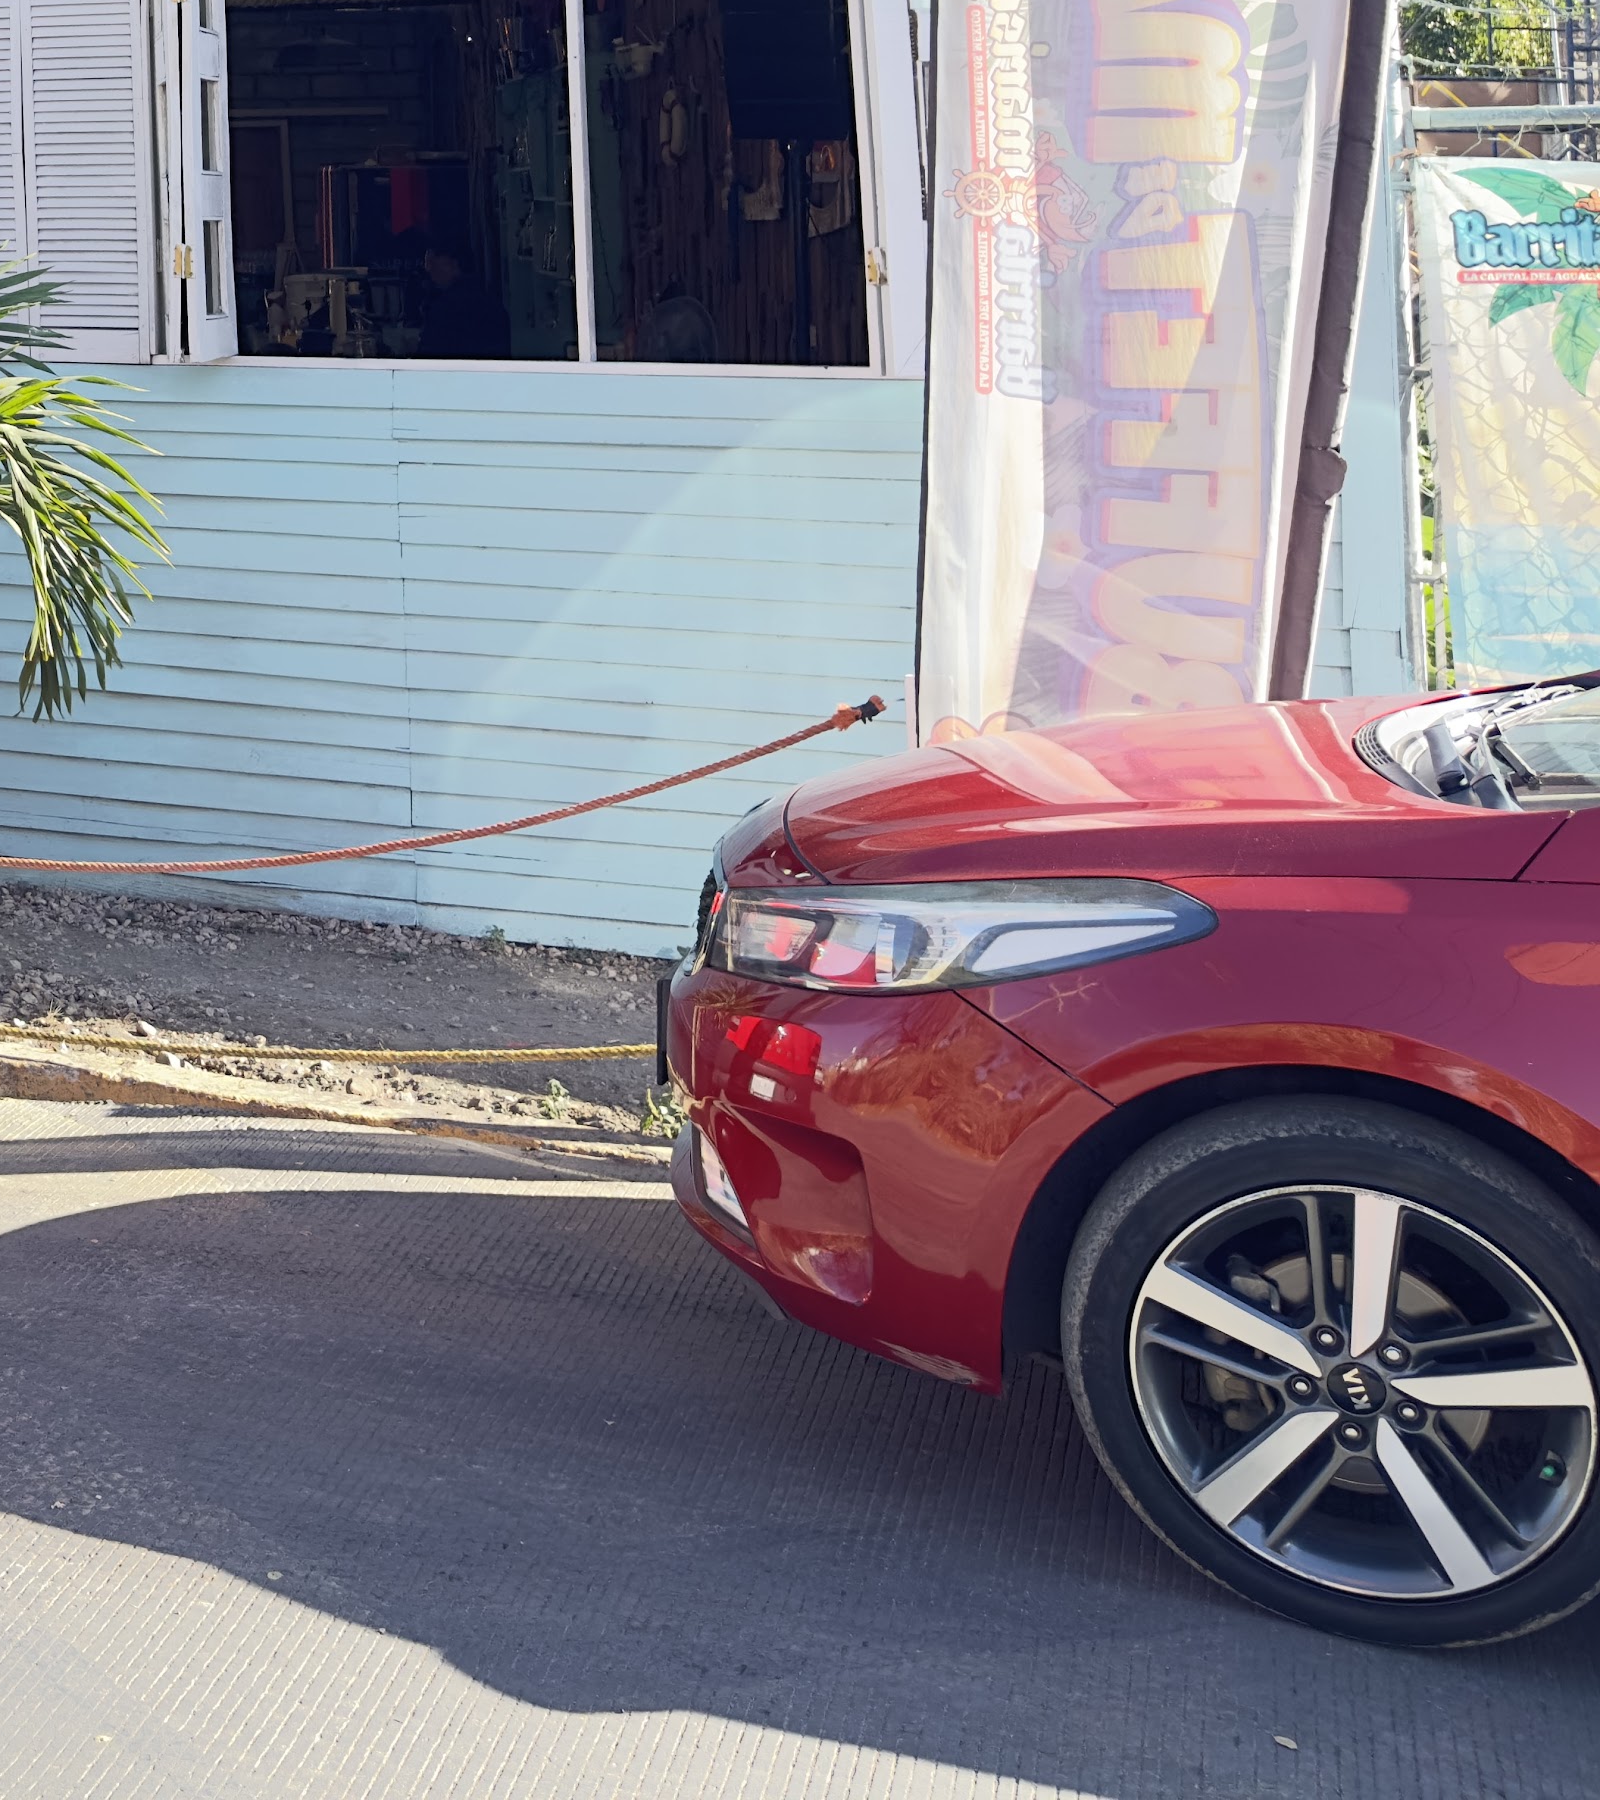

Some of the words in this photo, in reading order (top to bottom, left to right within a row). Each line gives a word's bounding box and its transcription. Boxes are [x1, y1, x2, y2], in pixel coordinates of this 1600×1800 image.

[1450, 207, 1600, 268] Barrit
[1463, 272, 1480, 281] LA
[1480, 272, 1529, 281] CAPITAL
[1530, 272, 1554, 281] DEL
[1342, 1367, 1372, 1410] KIA
